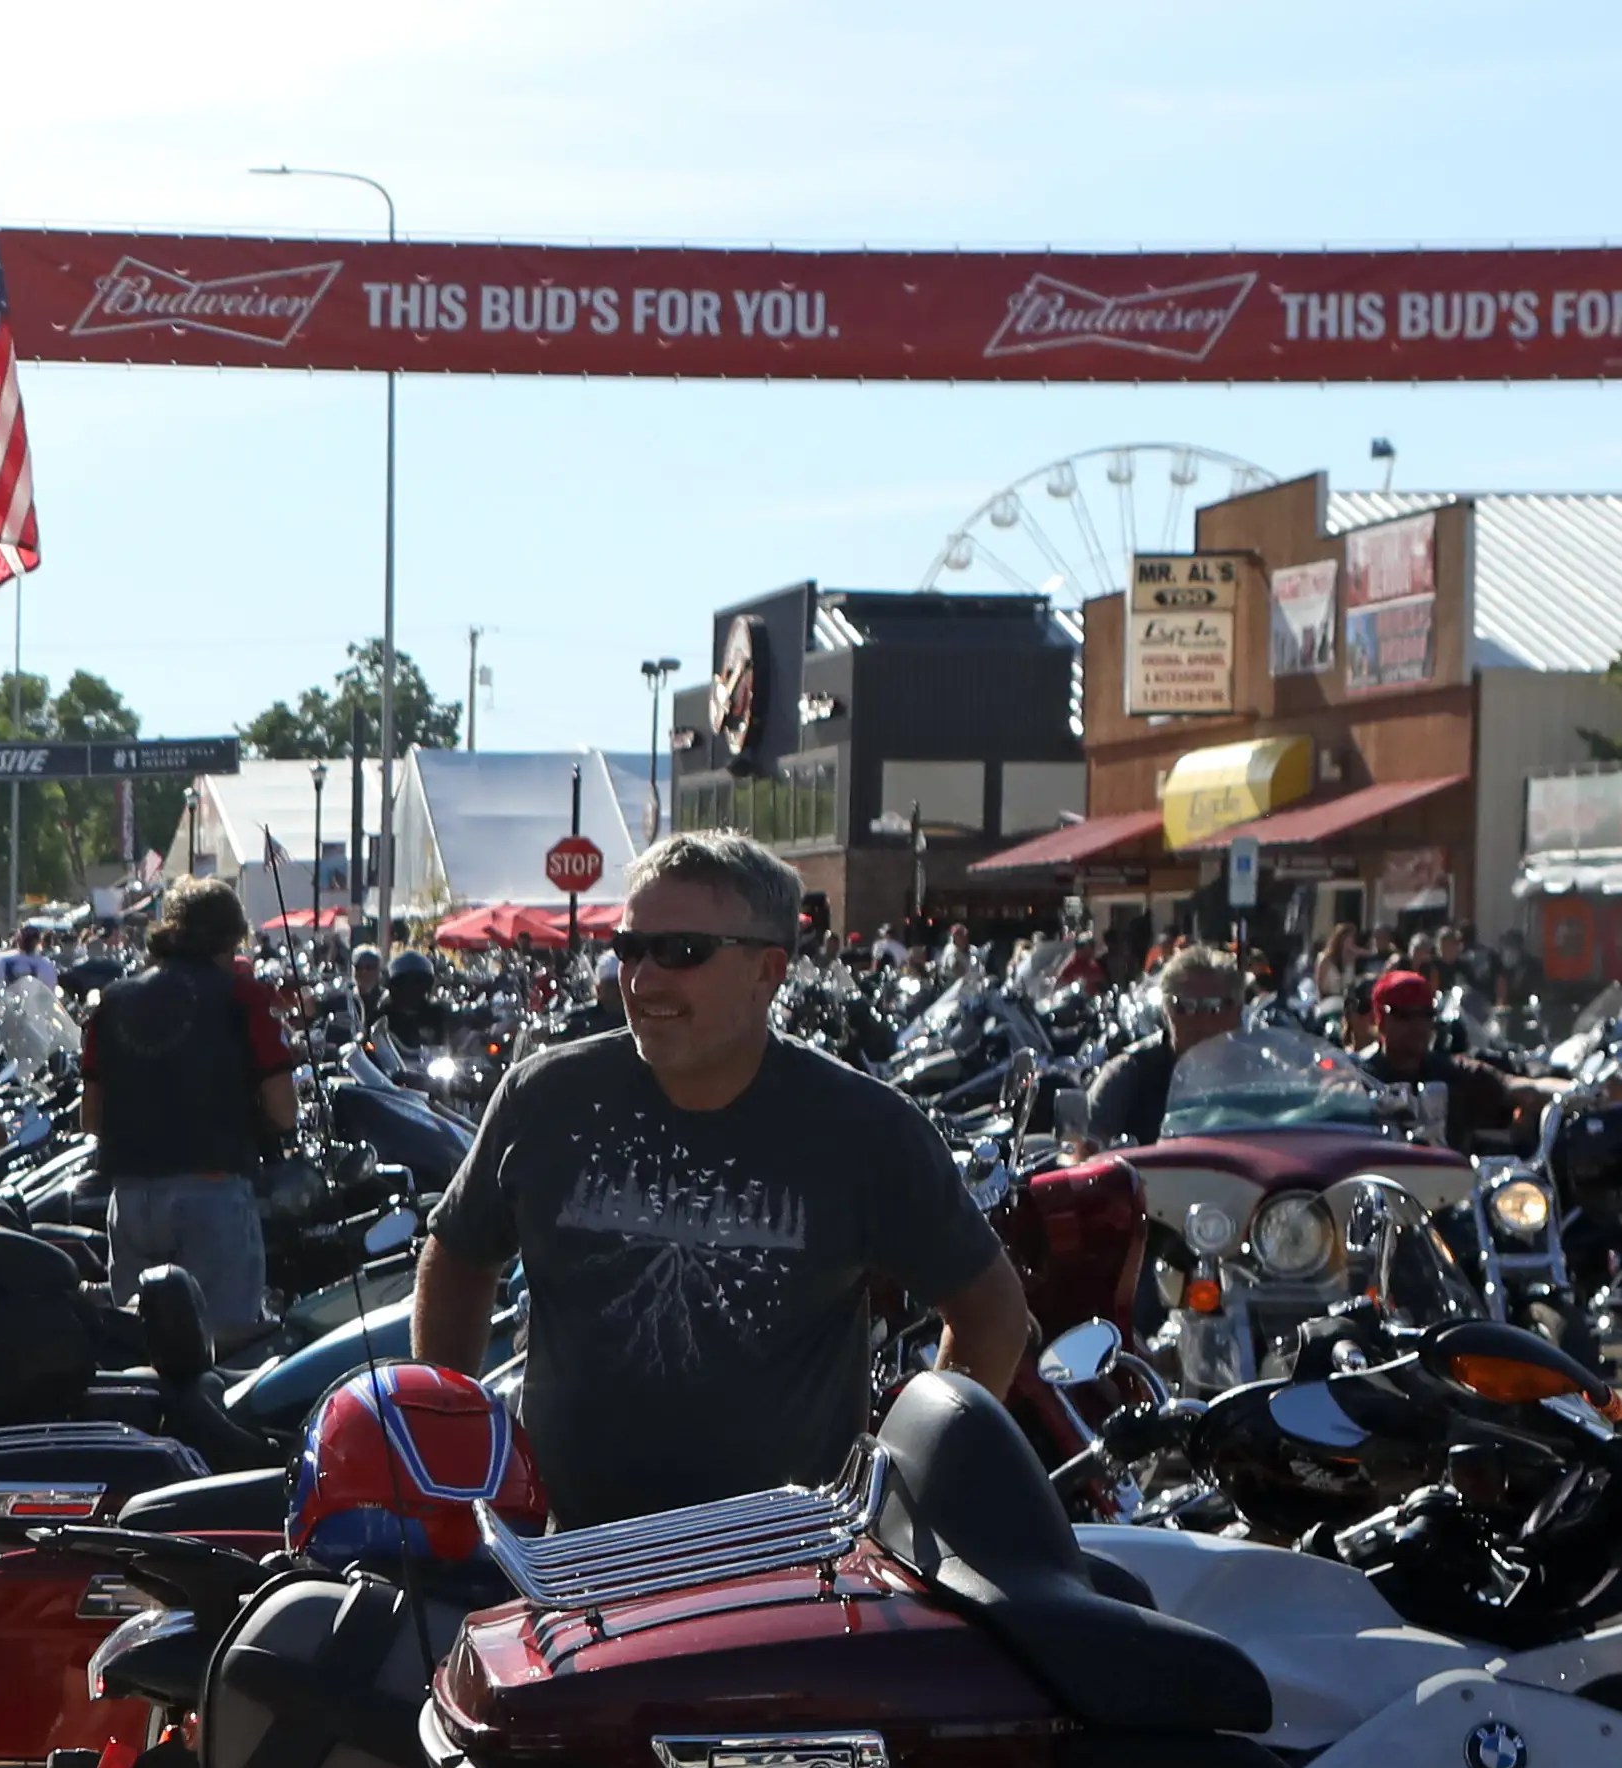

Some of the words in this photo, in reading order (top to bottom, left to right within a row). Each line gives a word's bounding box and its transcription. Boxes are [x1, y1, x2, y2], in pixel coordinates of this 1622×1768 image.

[94, 275, 314, 317] Budweiser
[362, 281, 468, 331] THIS
[480, 284, 621, 334] BUD'S
[632, 287, 722, 337] FOR
[732, 289, 840, 339] YOU.
[1007, 291, 1232, 335] Budweiser
[1280, 291, 1387, 342] THIS
[1398, 290, 1540, 341] BUD'S
[1138, 562, 1177, 584] MR.
[1188, 561, 1235, 584] AL'S
[113, 748, 137, 769] #1
[549, 852, 600, 876] STOP
[1476, 1722, 1525, 1749] BMW
